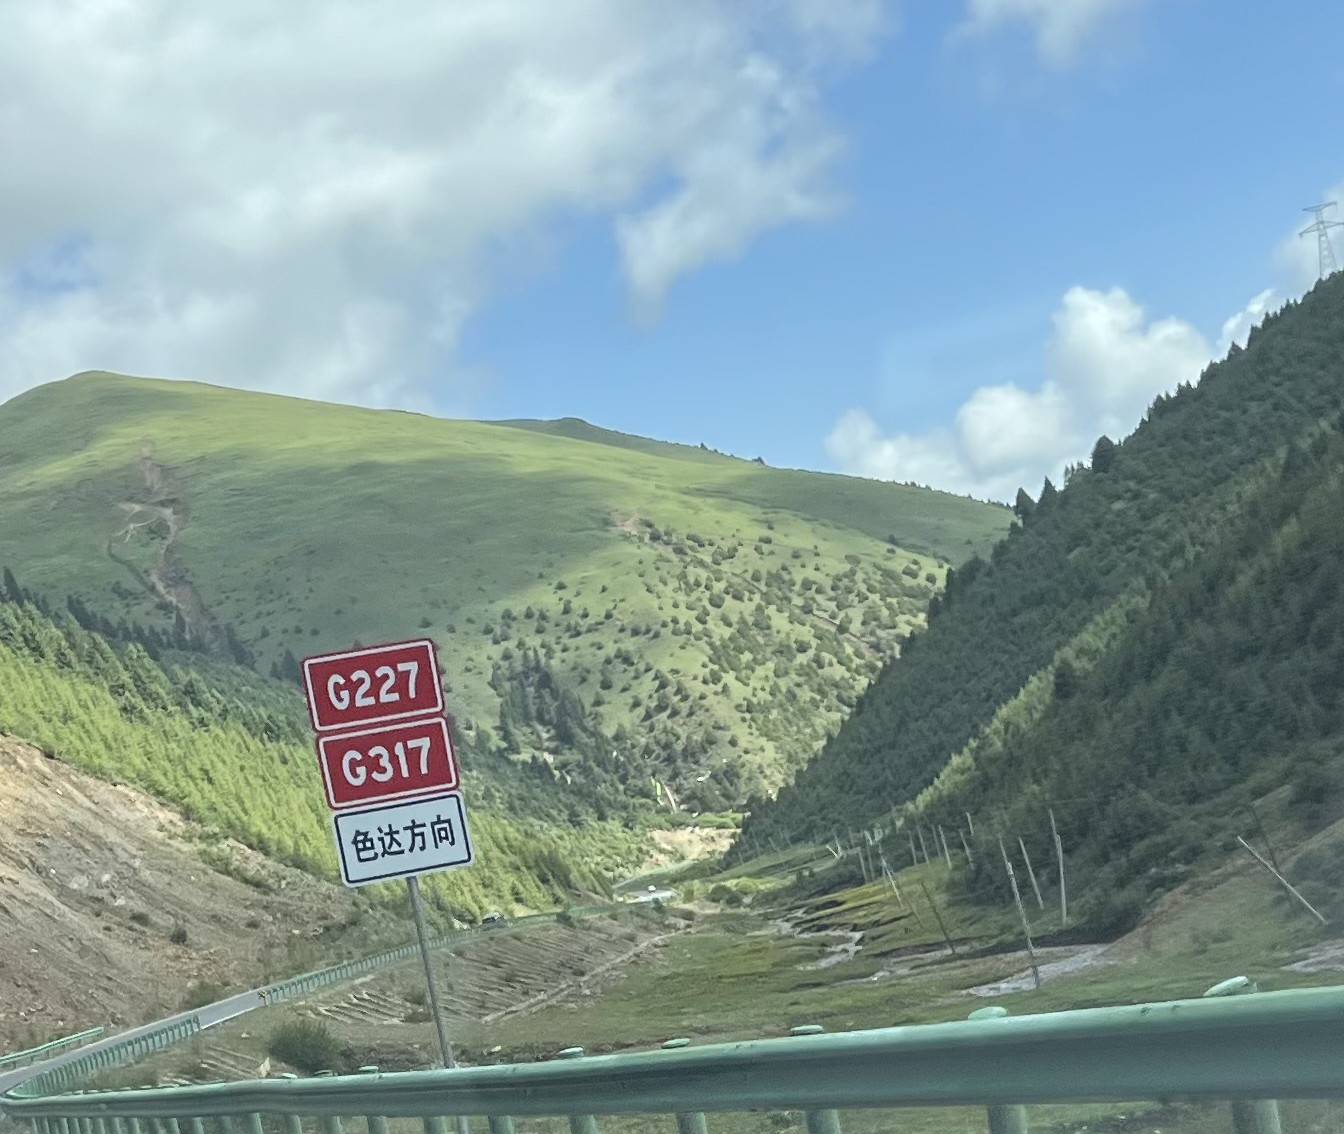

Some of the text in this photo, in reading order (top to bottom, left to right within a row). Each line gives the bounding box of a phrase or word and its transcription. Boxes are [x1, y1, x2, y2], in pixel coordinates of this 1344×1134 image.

[327, 661, 419, 710] G227
[342, 737, 431, 786] G317
[351, 815, 455, 863] 色达方向
